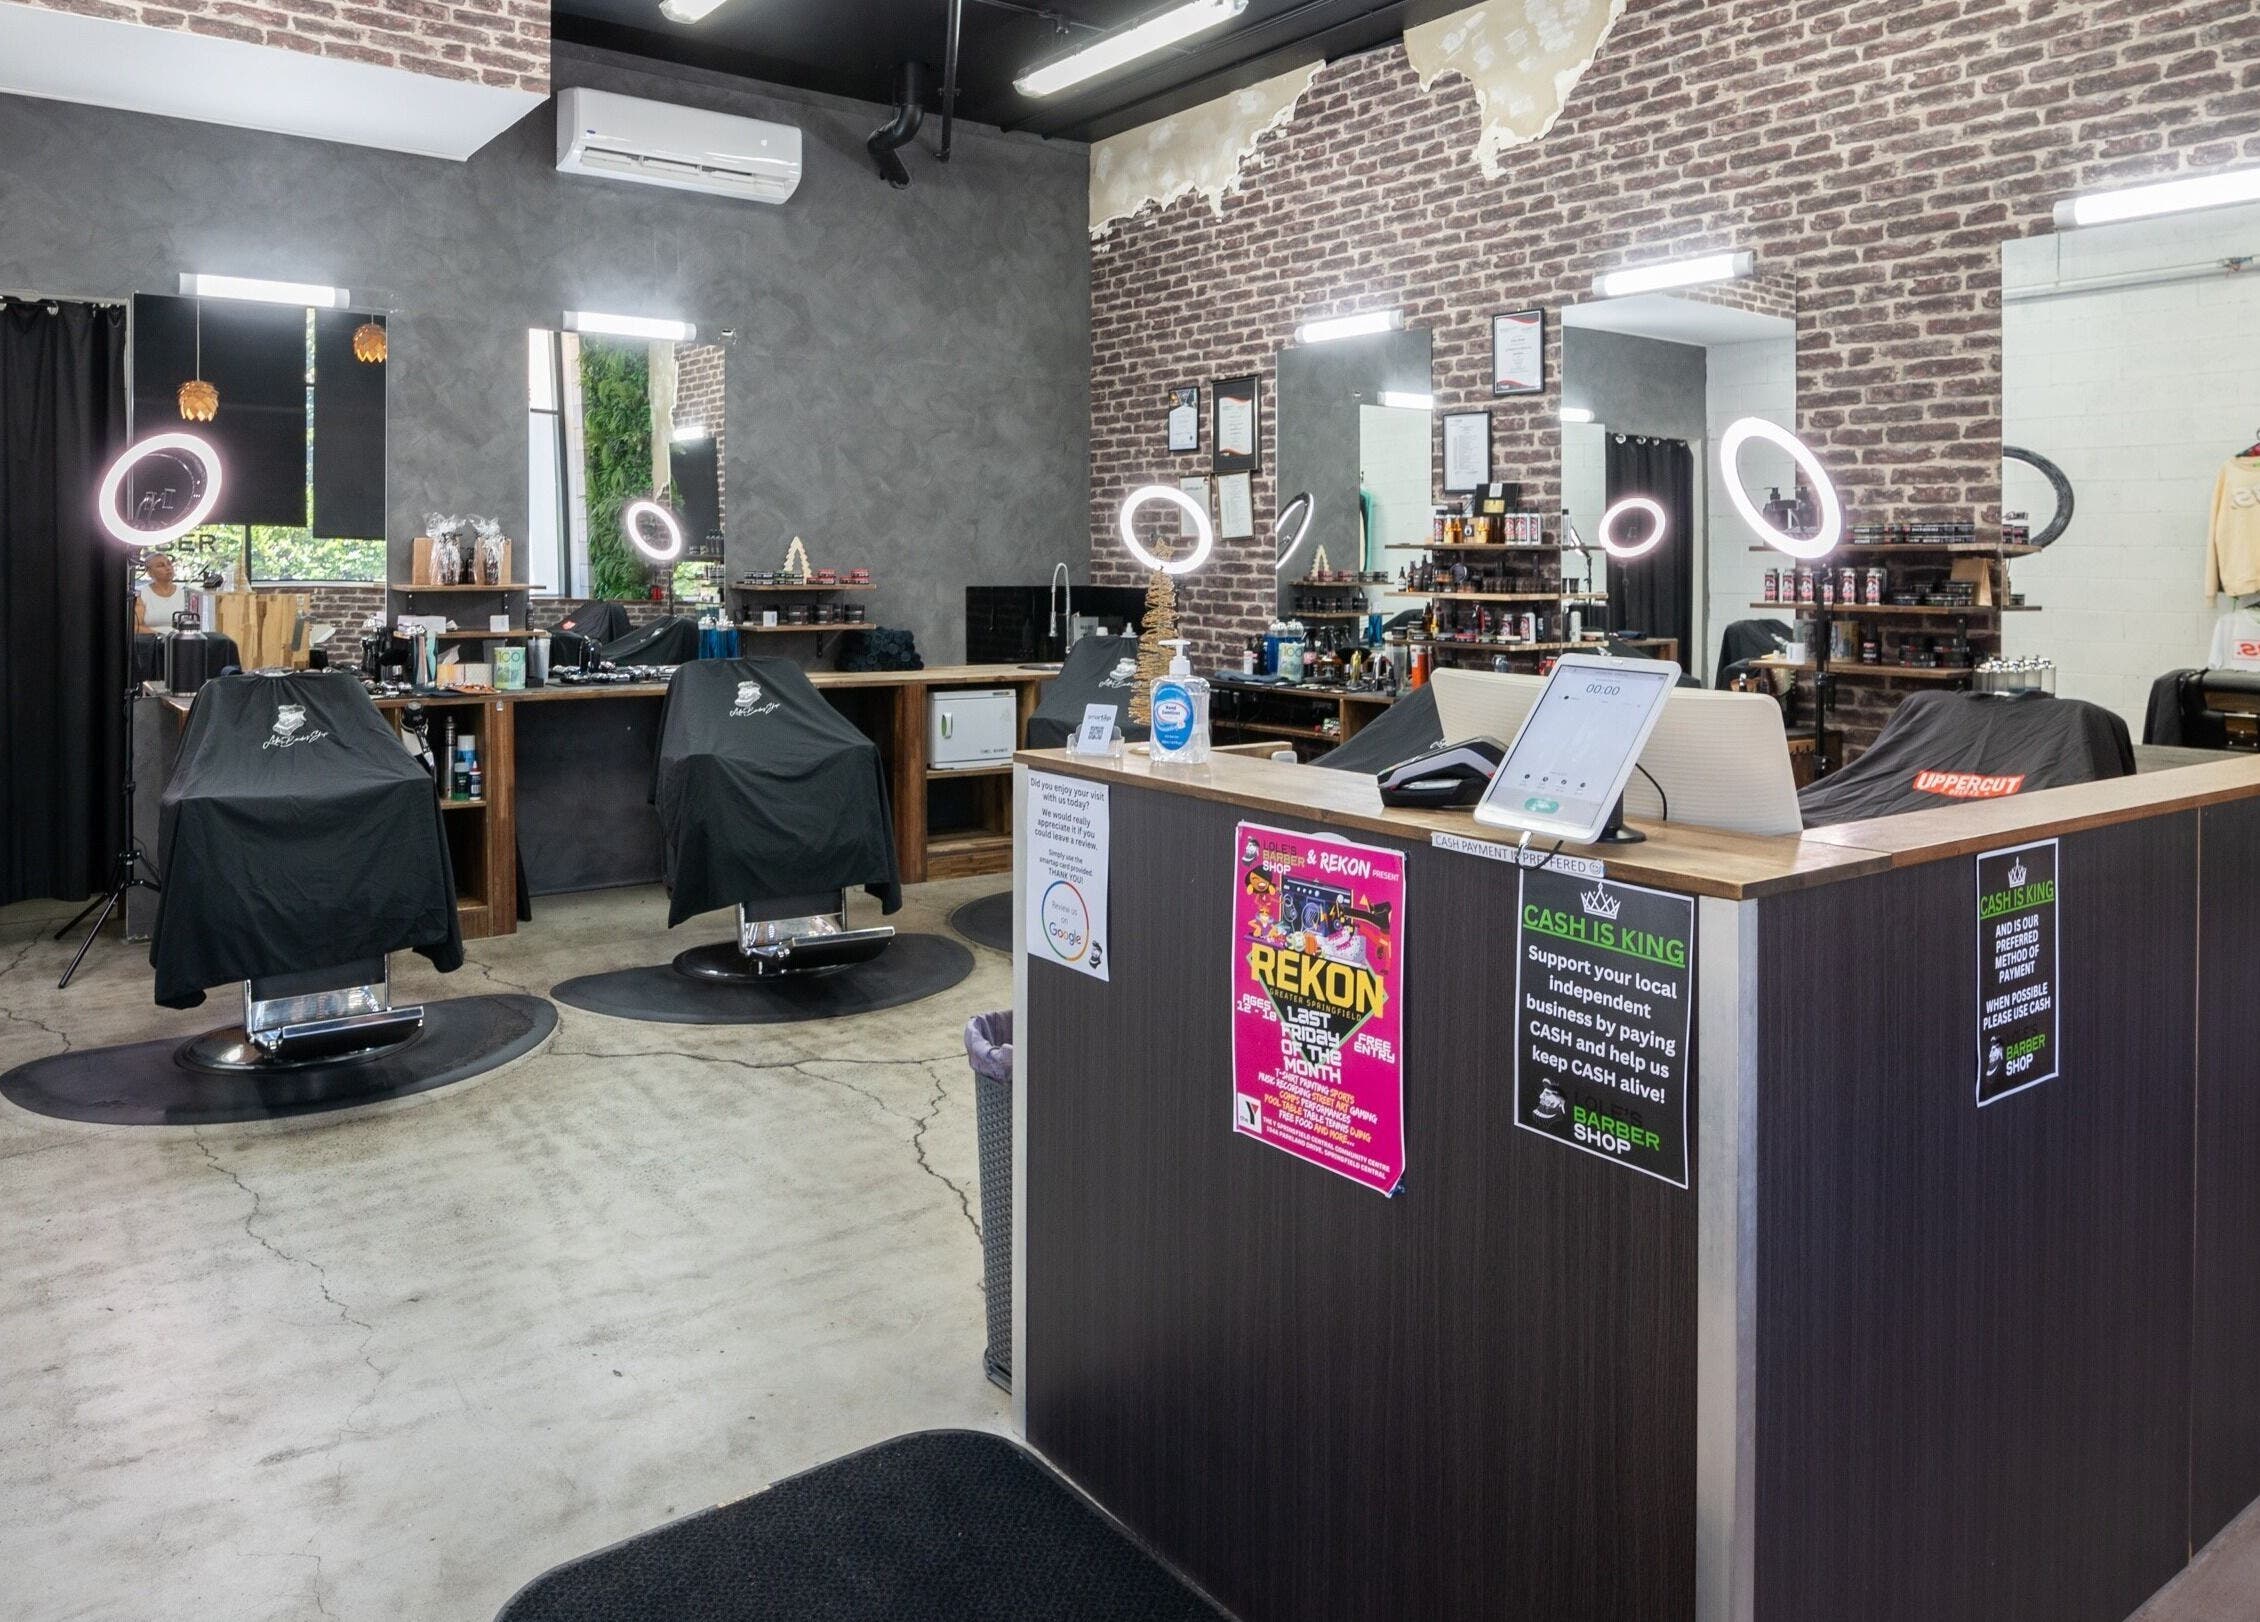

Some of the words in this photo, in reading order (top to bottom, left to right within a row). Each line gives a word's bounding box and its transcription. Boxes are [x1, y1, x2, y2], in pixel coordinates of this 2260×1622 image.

[499, 650, 521, 663] 100
[1586, 683, 1620, 696] 00:00
[1031, 778, 1040, 788] Did
[1042, 782, 1053, 791] you
[1054, 784, 1072, 796] enjoy
[1074, 788, 1088, 798] your
[1090, 790, 1104, 802] visit
[1917, 772, 2021, 795] UPPERCUT
[1043, 792, 1057, 803] with
[1067, 798, 1090, 811] today?
[1038, 818, 1070, 832] appreciate
[1071, 826, 1076, 834] it
[1077, 826, 1082, 835] if
[1083, 830, 1095, 838] you
[1042, 808, 1051, 818] We
[1052, 812, 1071, 822] would
[1073, 816, 1090, 828] really
[1034, 828, 1051, 838] could
[1052, 832, 1069, 842] leave
[1075, 839, 1098, 850] review.
[1263, 840, 1296, 855] LOLE'S
[1436, 837, 1459, 850] CASH
[1462, 841, 1506, 859] PAYMENT
[1048, 849, 1065, 860] Simply
[1074, 856, 1082, 864] the
[1262, 850, 1304, 867] BARBER
[1262, 862, 1291, 875] SHOP
[1307, 849, 1317, 865] &
[1320, 852, 1371, 879] REKON
[1372, 870, 1399, 882] PRESENT
[1048, 868, 1067, 880] THANK
[1069, 874, 1084, 885] YOU!
[1052, 900, 1070, 913] Review
[1981, 891, 2011, 915] CASH
[2014, 887, 2024, 907] IS
[2026, 880, 2054, 903] KING
[1061, 916, 1068, 924] on
[1996, 922, 2012, 938] AND
[2014, 919, 2021, 932] IS
[2022, 914, 2039, 930] OUR
[1049, 922, 1081, 946] Google
[1524, 904, 1585, 939] CASH
[1594, 921, 1615, 945] IS
[1622, 928, 1684, 963] KING
[1996, 929, 2038, 954] PREFERRED
[1995, 948, 2028, 969] METHOD
[2029, 944, 2040, 958] OF
[1252, 943, 1384, 1018] REKON
[1528, 945, 1591, 975] Support
[1594, 965, 1632, 986] your
[1636, 973, 1677, 999] local
[1999, 960, 2035, 984] PAYMENT
[1243, 994, 1271, 1010] AGES
[1270, 988, 1303, 1004] GREATER
[1306, 999, 1361, 1021] SPRINGFIELD
[1550, 975, 1651, 1019] independent
[1986, 994, 2010, 1013] WHEN
[2012, 982, 2048, 1005] POSSIBLE
[1237, 1000, 1251, 1013] 12
[1262, 1010, 1276, 1022] 18
[1983, 1009, 2012, 1030] PLEASE
[2014, 1003, 2028, 1020] USE
[2030, 996, 2051, 1014] CASH
[1526, 993, 1592, 1027] business
[1596, 1014, 1616, 1037] by
[1620, 1025, 1675, 1057] paying
[1281, 1040, 1302, 1056] OF
[1307, 1046, 1342, 1066] THE
[1354, 1042, 1395, 1064] ENTRY
[1358, 1033, 1391, 1050] FREE
[1530, 1021, 1572, 1047] CASH
[1576, 1037, 1605, 1058] and
[1610, 1045, 1646, 1073] help
[1650, 1061, 1670, 1078] us
[2006, 1034, 2046, 1060] BARBER
[1283, 1056, 1341, 1084] MONTH
[1532, 1045, 1567, 1073] keep
[1571, 1060, 1616, 1087] CASH
[1620, 1077, 1665, 1104] alive!
[2006, 1053, 2033, 1076] SHOP
[1258, 1071, 1276, 1086] MUSIC
[1276, 1079, 1312, 1099] RECORDING
[1312, 1092, 1335, 1108] STREET
[1335, 1100, 1350, 1113] ART
[1350, 1106, 1378, 1125] GAMING
[1275, 1068, 1299, 1084] T-SHIRT
[1300, 1076, 1329, 1095] PAINTING
[1330, 1088, 1355, 1104] SPORTS
[1264, 1093, 1281, 1107] POOL
[1282, 1101, 1303, 1116] TABLE
[1303, 1108, 1324, 1124] TABLE
[1325, 1117, 1349, 1134] TENNIS
[1350, 1126, 1372, 1143] DJING
[1280, 1090, 1300, 1104] COMPS
[1301, 1097, 1351, 1124] PERFORMANCES
[1279, 1109, 1294, 1122] FREE
[1295, 1116, 1313, 1130] FOOD
[1313, 1124, 1329, 1136] AND
[1573, 1106, 1660, 1151] BARBER
[1262, 1116, 1272, 1125] THE
[1277, 1122, 1311, 1140] SPRINGFIELD
[1311, 1136, 1334, 1150] CENTRAL
[1334, 1146, 1368, 1164] COMMUNITY
[1368, 1158, 1390, 1172] CENTRE
[1574, 1124, 1631, 1154] SHOP
[1324, 1150, 1360, 1169] SPRINGFIELD
[1360, 1163, 1386, 1180] CENTRAL
